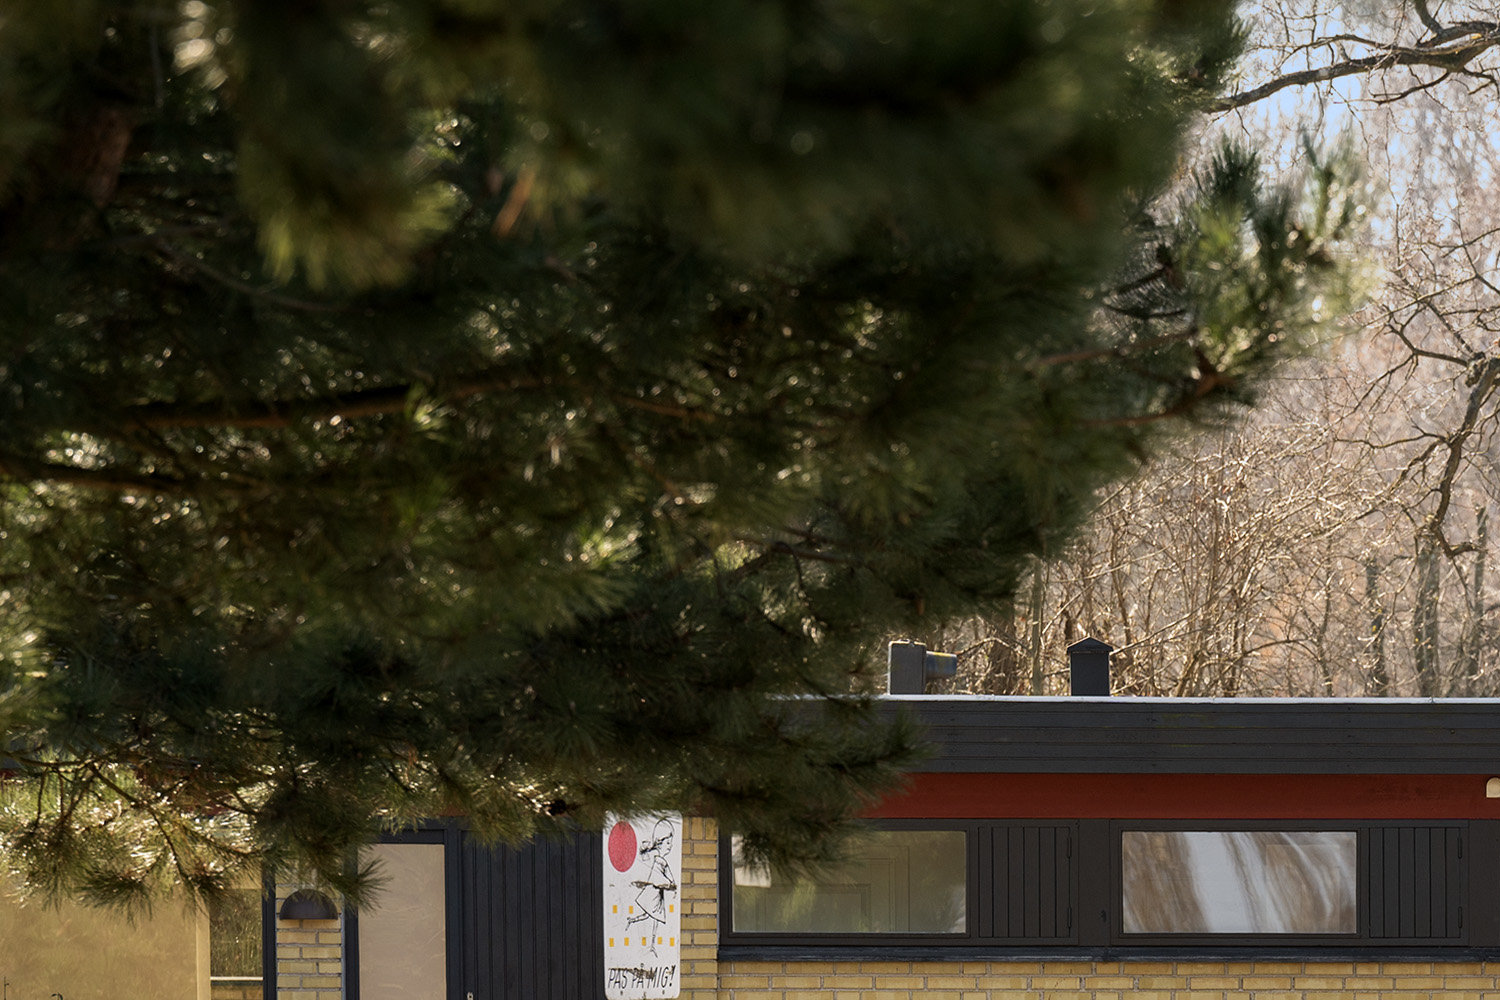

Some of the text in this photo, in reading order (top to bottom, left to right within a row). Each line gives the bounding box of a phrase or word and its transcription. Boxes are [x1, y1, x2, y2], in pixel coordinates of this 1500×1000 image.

[607, 962, 677, 990] PAS PÅ MIG!
